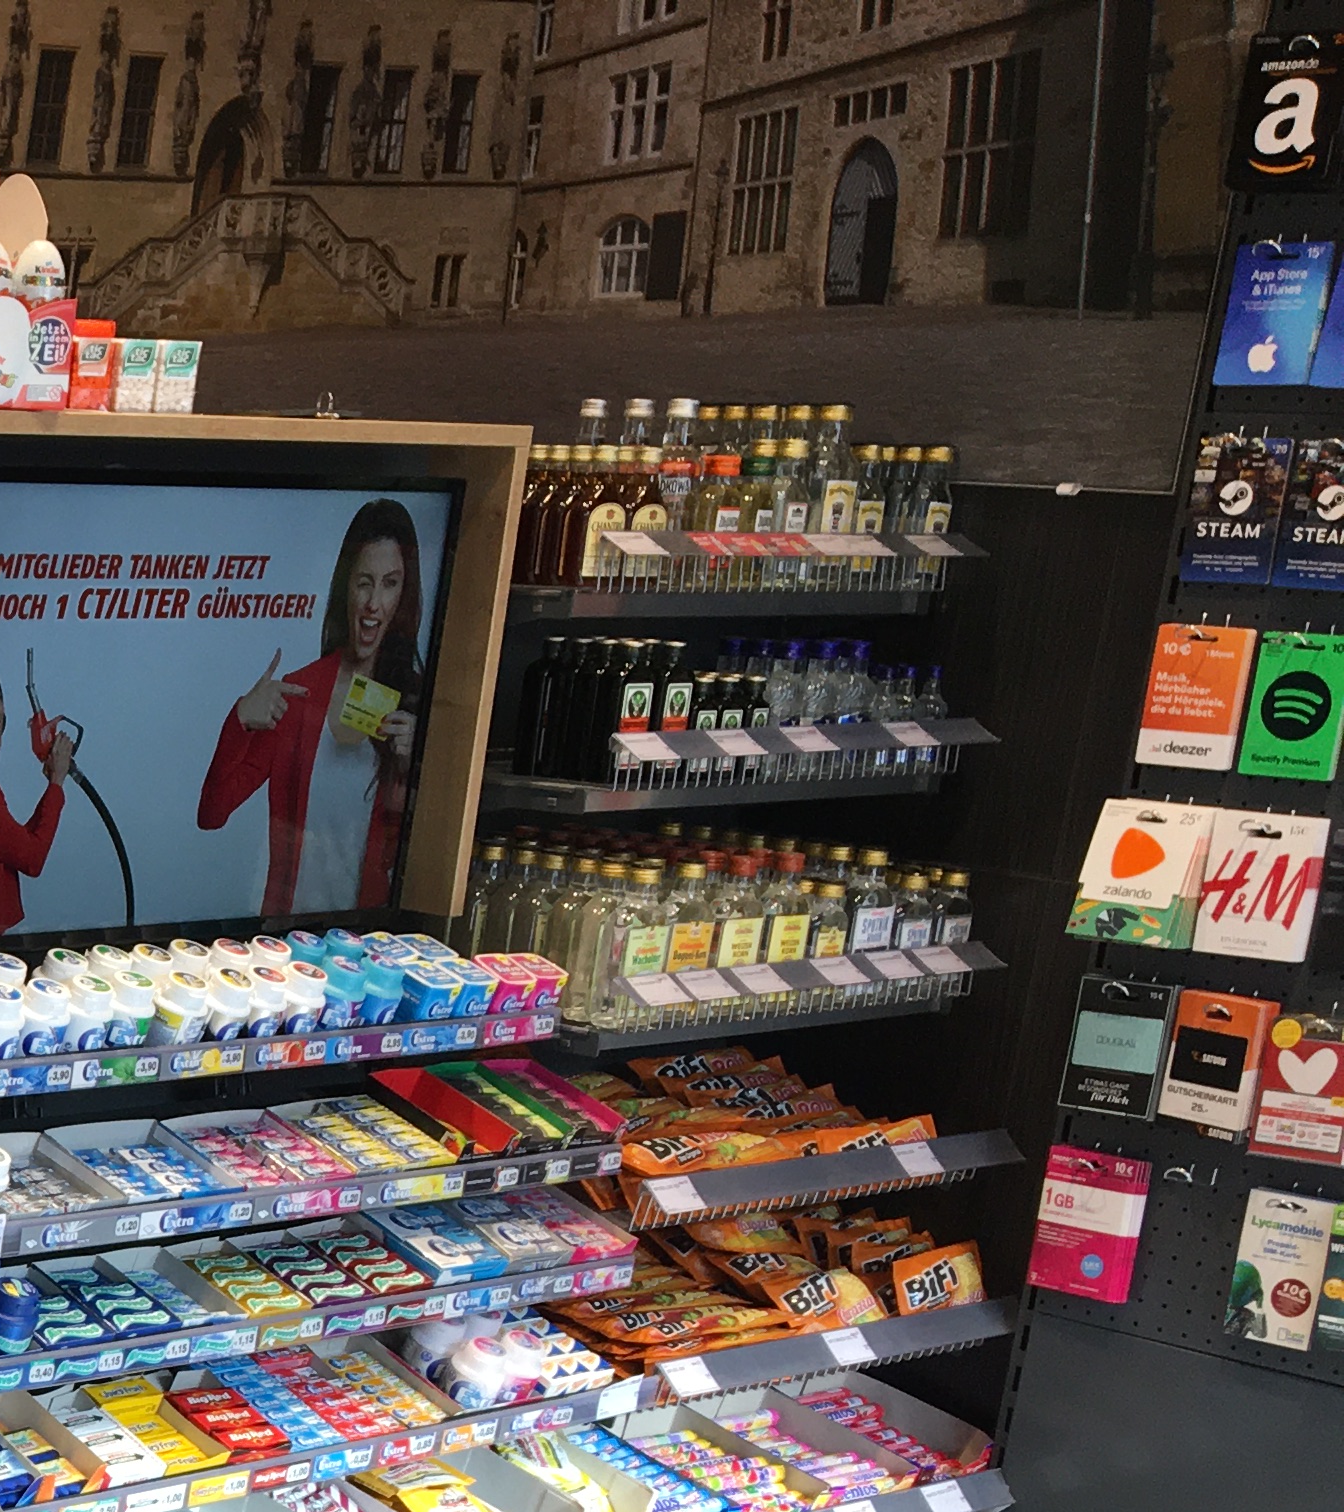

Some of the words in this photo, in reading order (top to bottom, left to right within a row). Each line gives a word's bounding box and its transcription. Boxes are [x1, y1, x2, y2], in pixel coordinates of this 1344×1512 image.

[1254, 78, 1320, 155] a
[1252, 269, 1275, 282] App
[1278, 268, 1308, 281] Store
[1263, 283, 1302, 295] iTunes
[1196, 522, 1261, 539] STEAM
[130, 554, 210, 580] TANKEN
[213, 555, 271, 580] JETZT
[56, 594, 70, 620] 1
[78, 588, 190, 619] CT/LITER
[197, 588, 317, 620] GÜNSTIGER!
[1156, 671, 1190, 684] Musik,
[1153, 694, 1171, 705] und
[1150, 703, 1167, 715] die
[1169, 705, 1181, 716] du
[1163, 741, 1212, 758] deezer
[1103, 884, 1152, 900] zalando
[1202, 849, 1313, 931] H&M
[1167, 1084, 1239, 1108] GUTSCHEINKARTE
[1054, 1194, 1075, 1210] GB
[1251, 1215, 1324, 1239] Lycamobile
